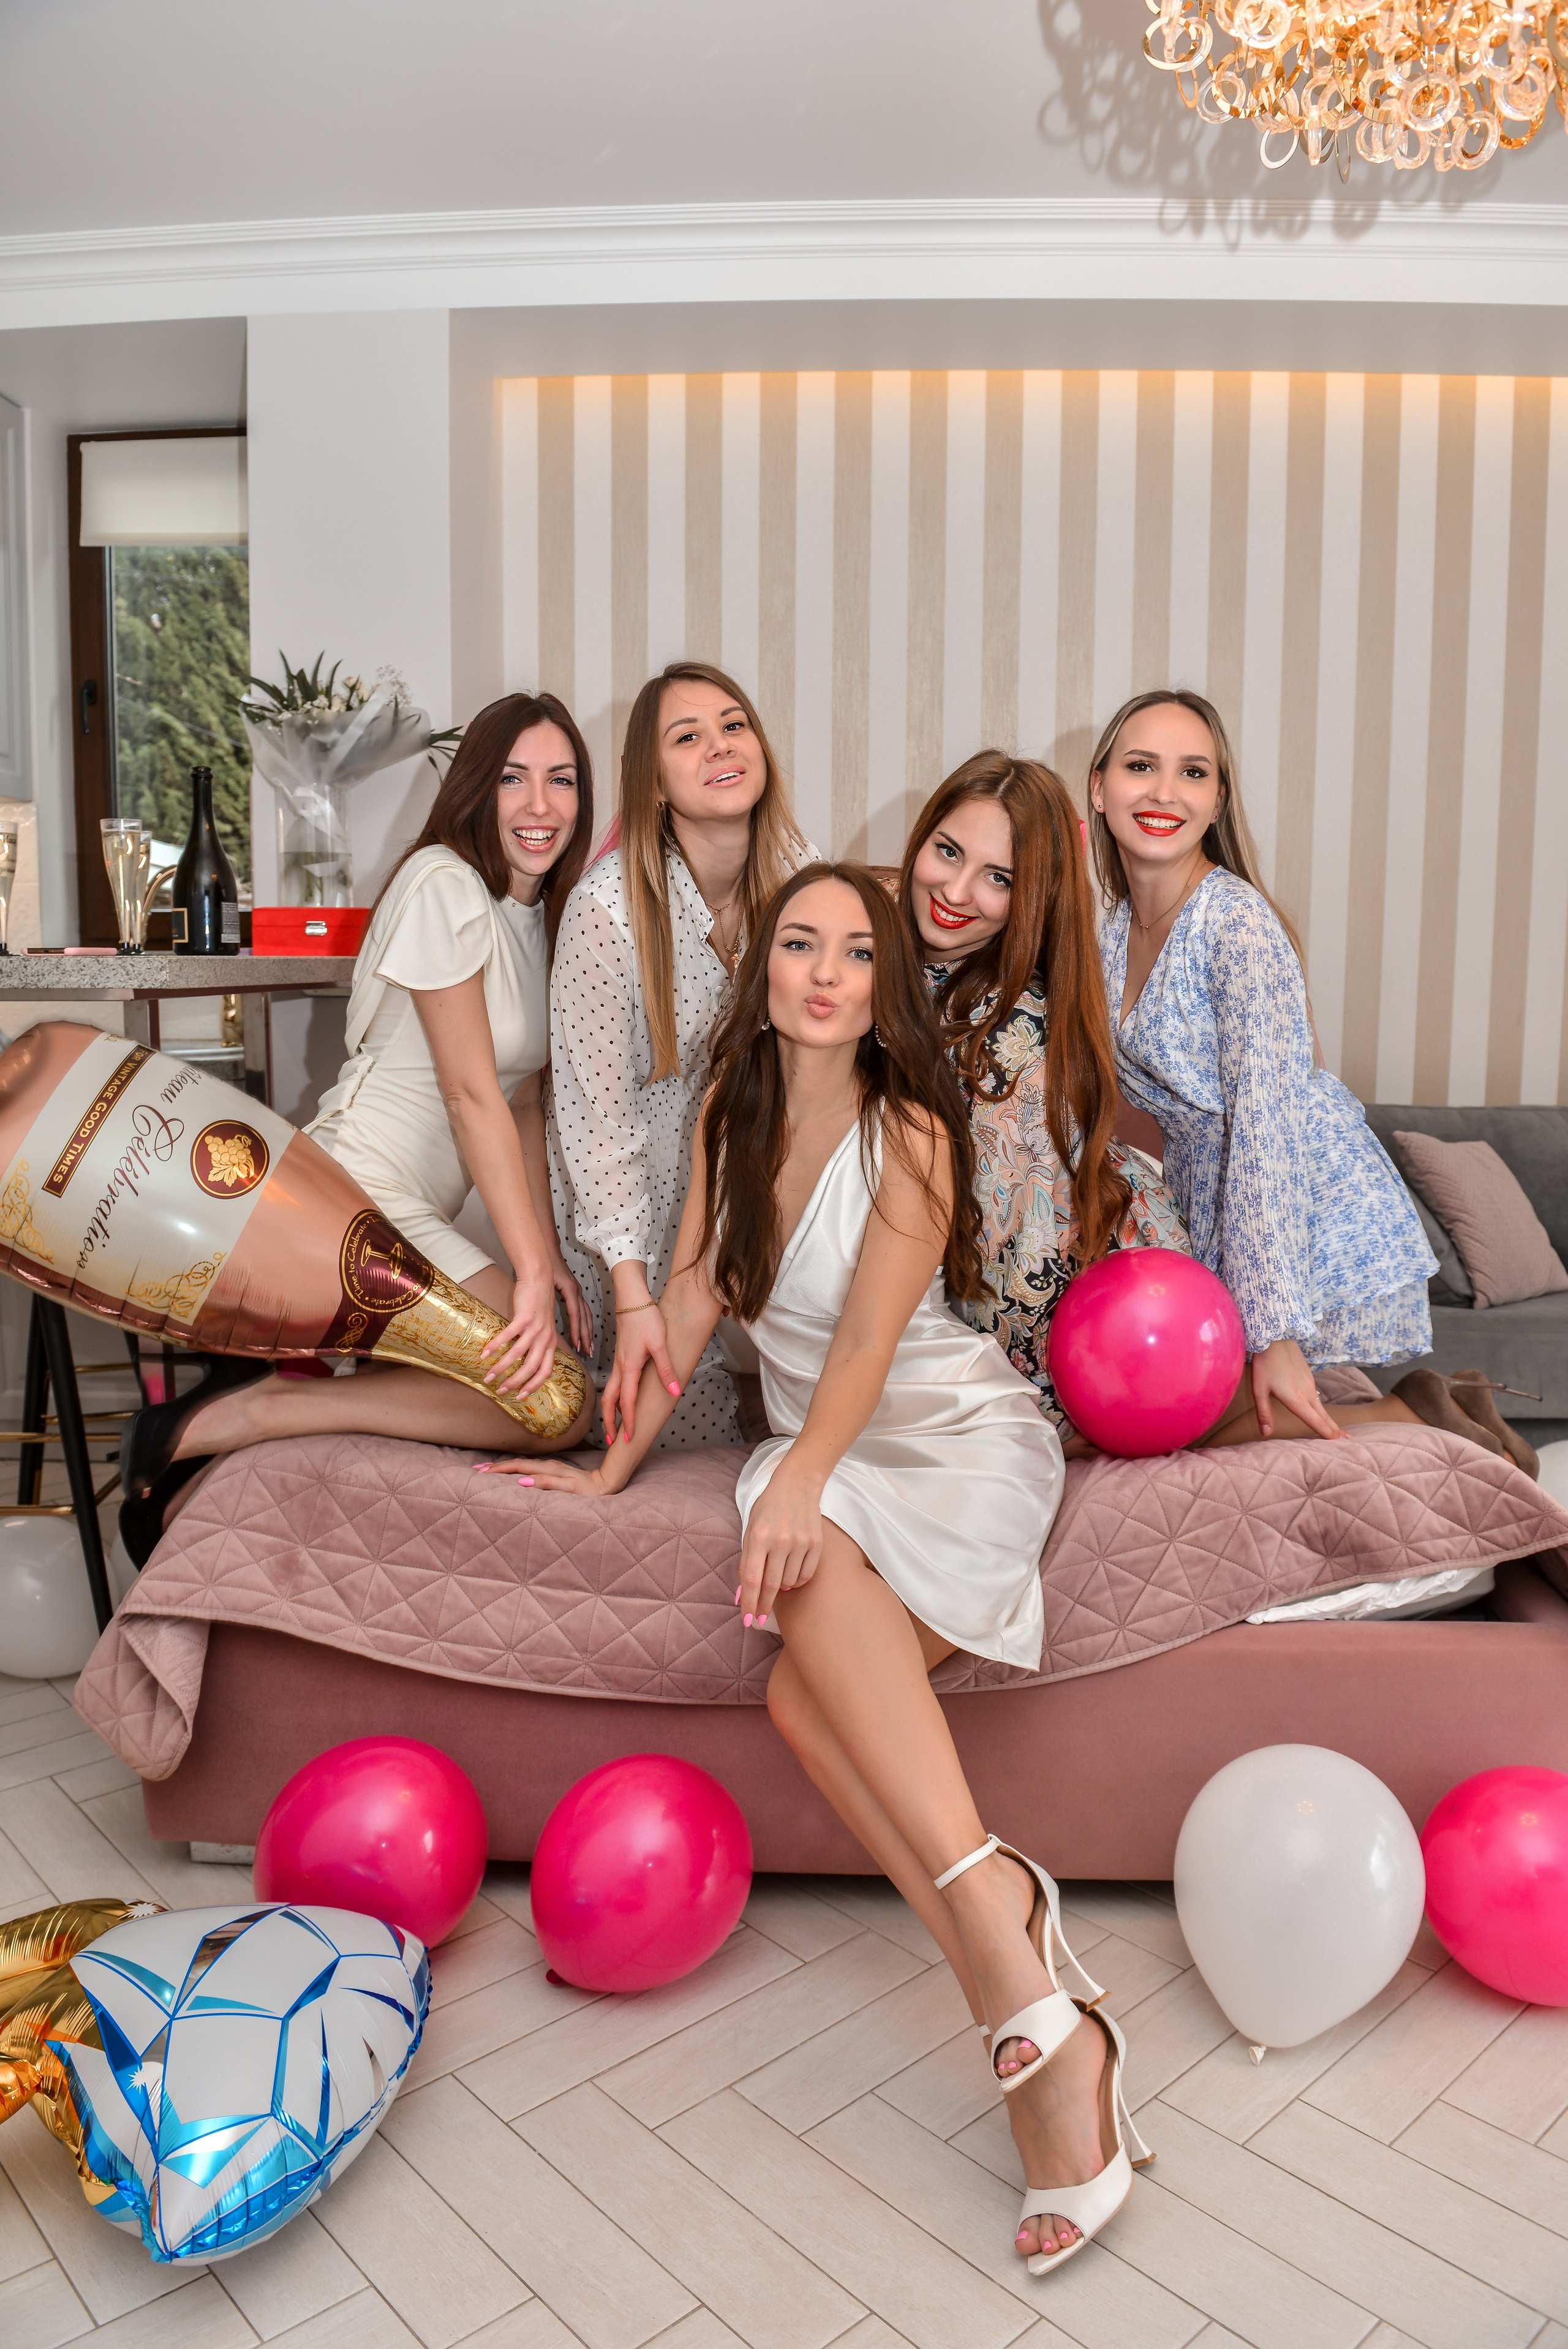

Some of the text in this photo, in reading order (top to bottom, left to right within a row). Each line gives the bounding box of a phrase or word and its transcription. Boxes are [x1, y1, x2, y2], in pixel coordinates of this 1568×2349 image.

[53, 1049, 148, 1184] FOR VINTAGE GOOD TIMES
[347, 1223, 368, 1299] Time to Celebrate
[371, 1291, 413, 1307] Celebrate
